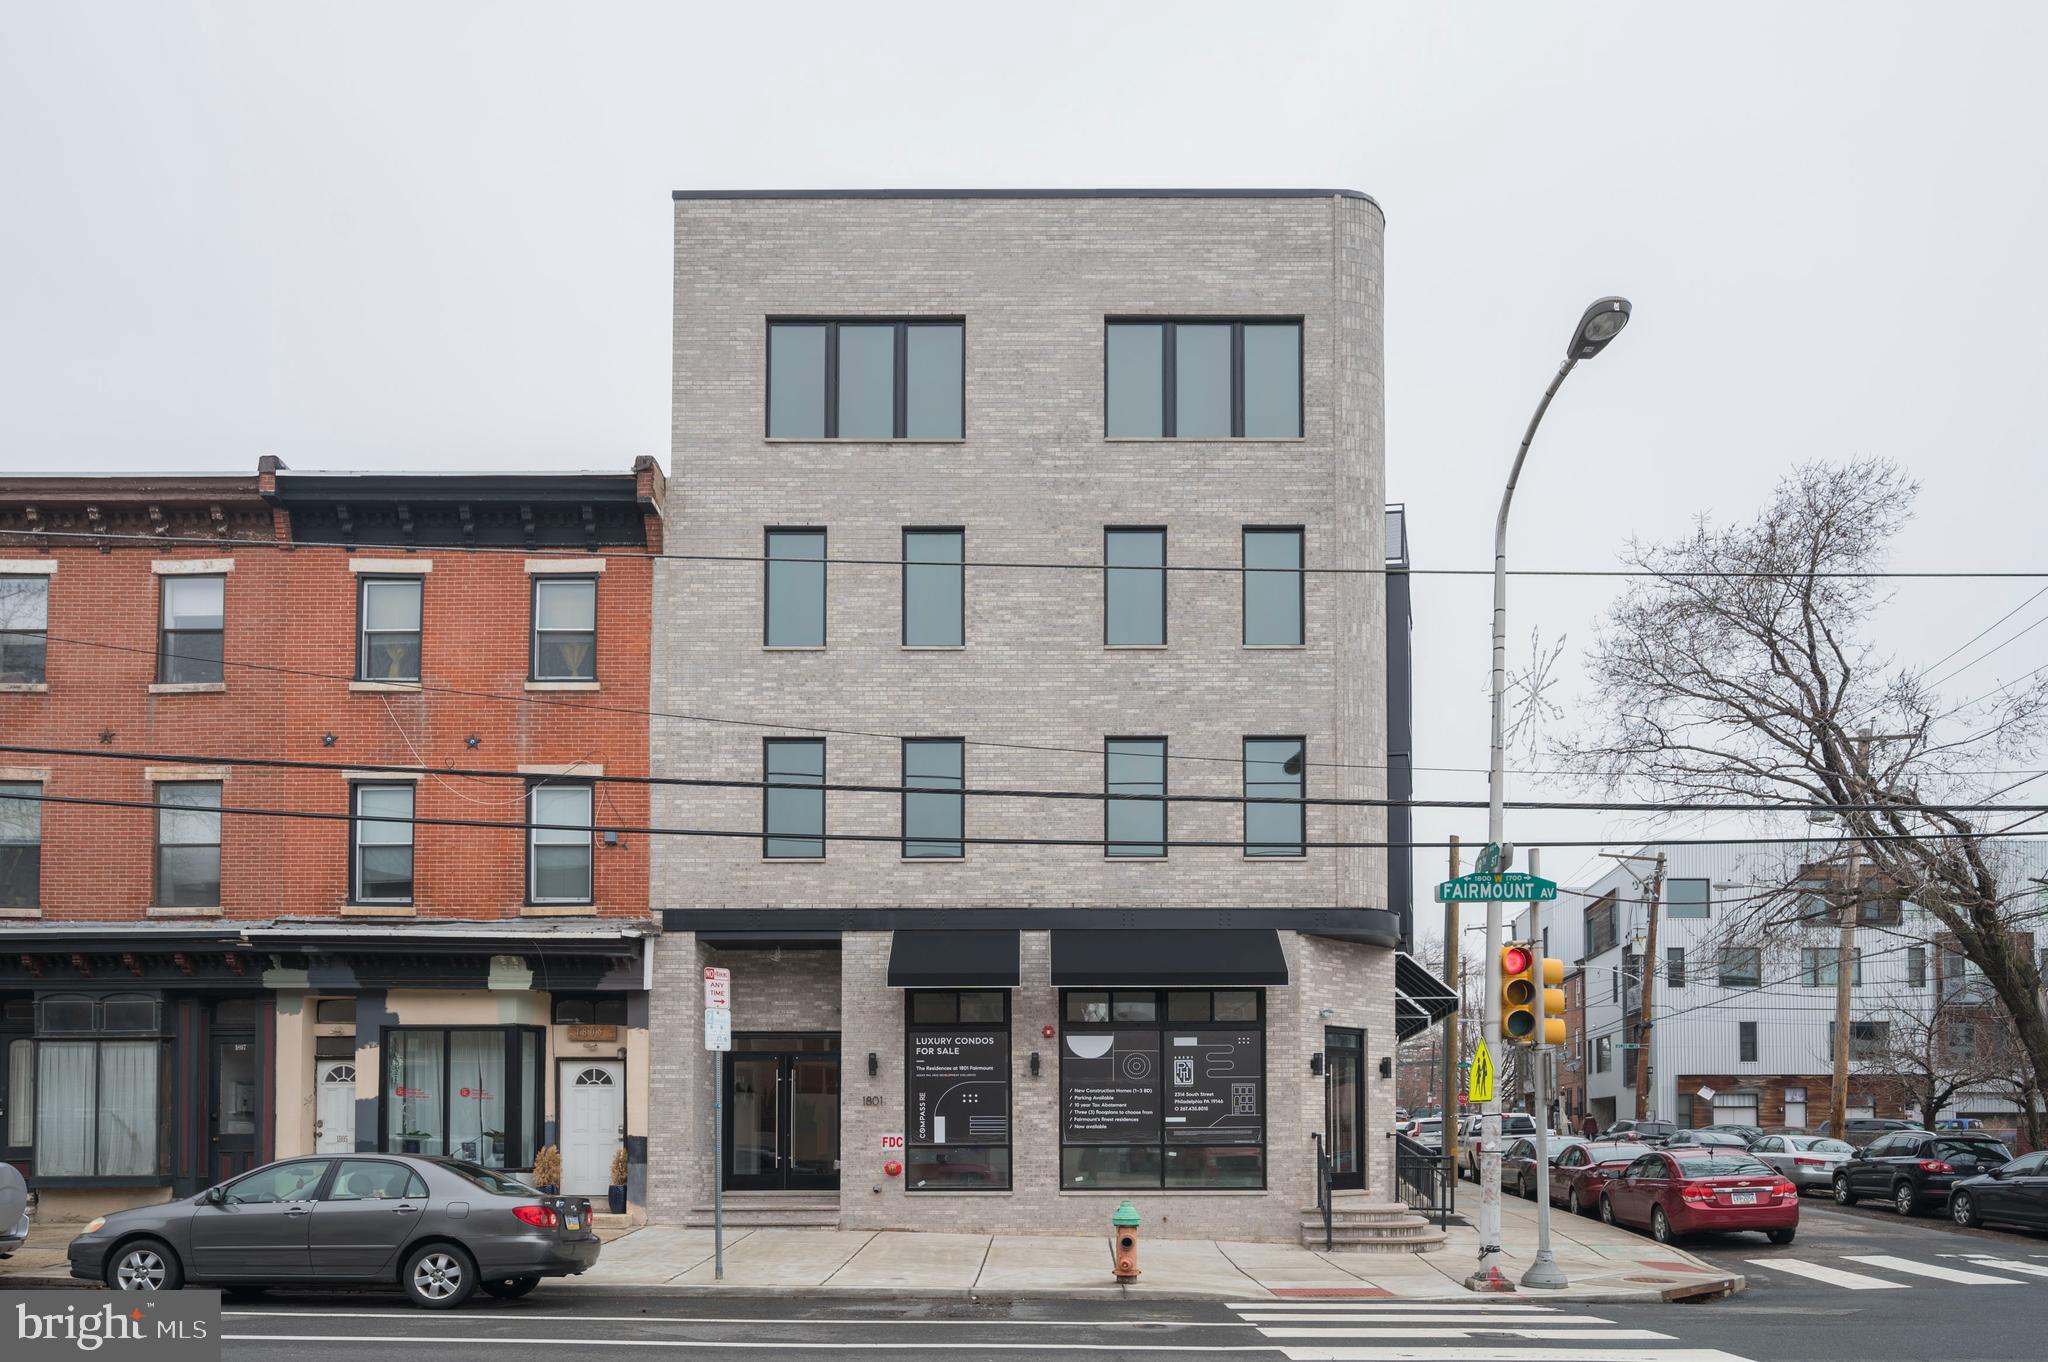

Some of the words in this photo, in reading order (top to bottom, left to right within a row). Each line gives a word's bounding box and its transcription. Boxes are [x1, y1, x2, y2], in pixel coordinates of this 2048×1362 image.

[1443, 883, 1534, 898] FAIRMOUNT
[1540, 888, 1554, 898] AV
[916, 1037, 952, 1045] LUXURY
[954, 1037, 994, 1045] CONDOS
[916, 1047, 934, 1055] FOR
[937, 1047, 960, 1055] SALE
[862, 1095, 883, 1106] 1801
[919, 1092, 926, 1100] RE
[882, 1136, 903, 1148] FDC
